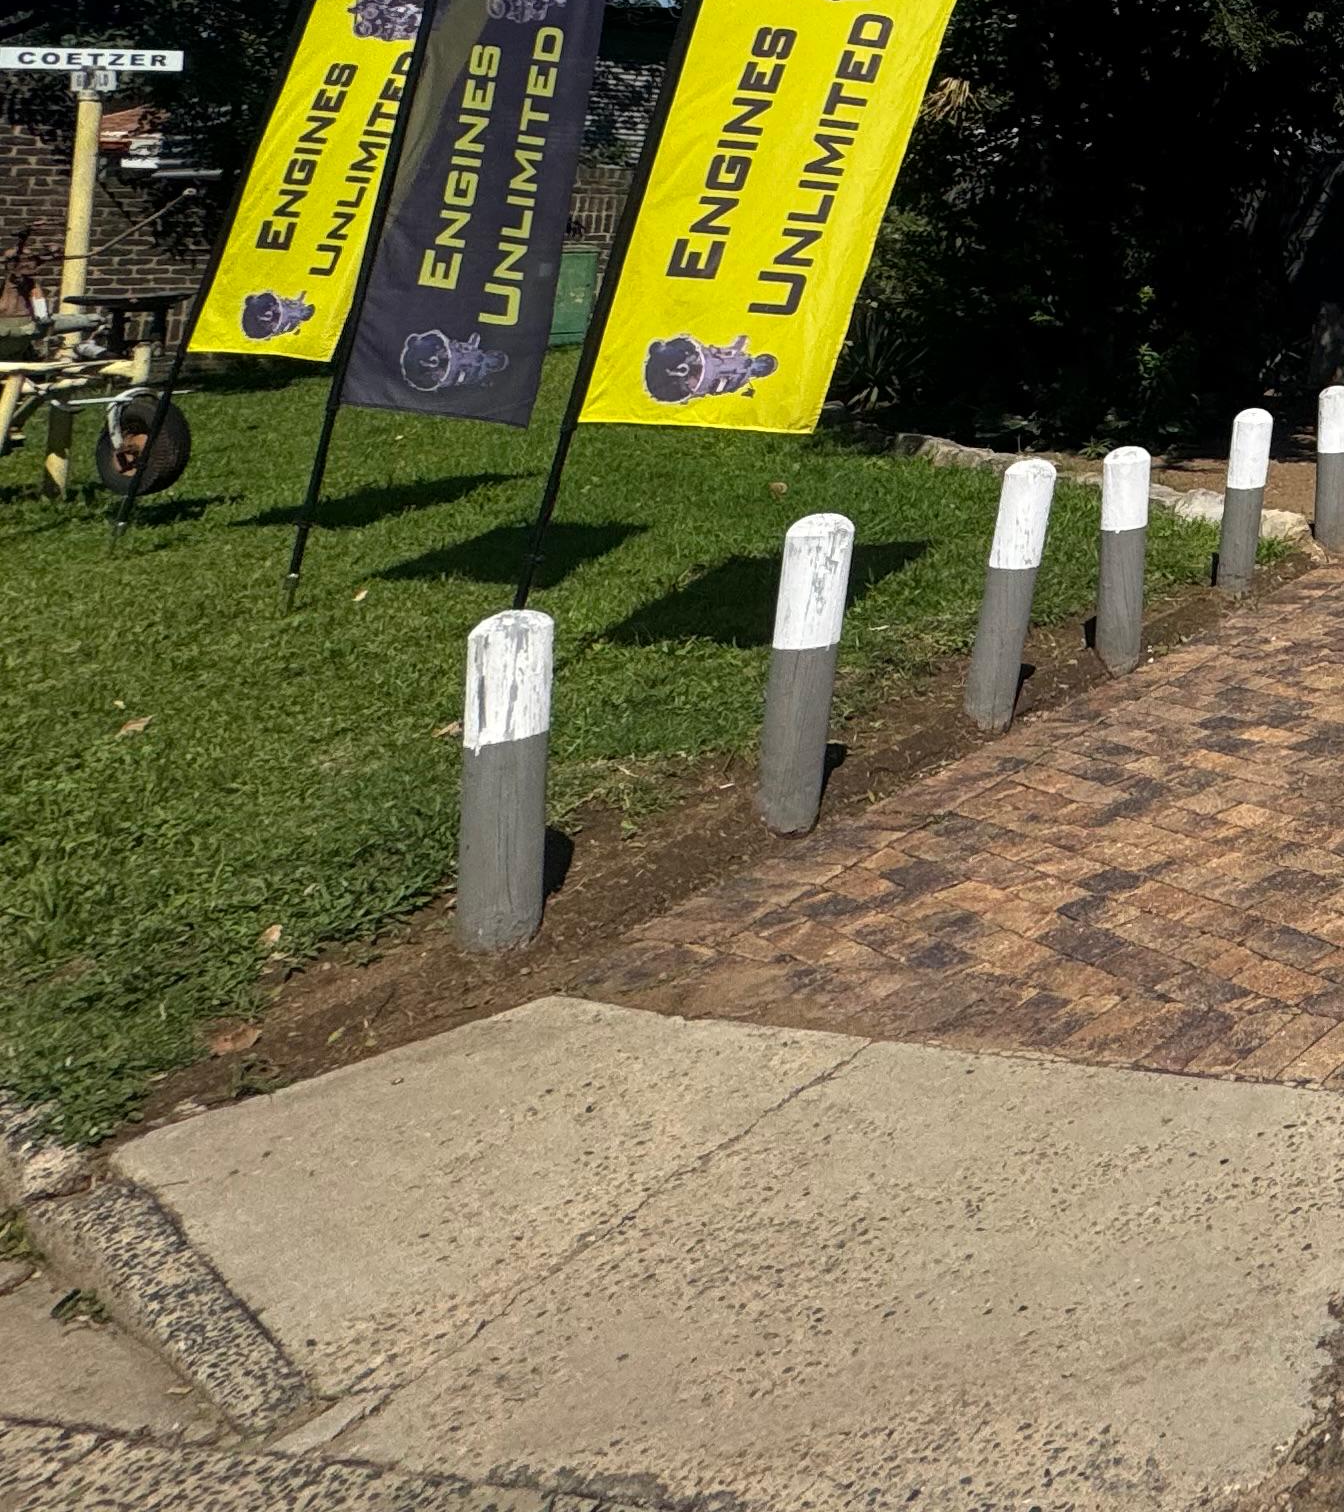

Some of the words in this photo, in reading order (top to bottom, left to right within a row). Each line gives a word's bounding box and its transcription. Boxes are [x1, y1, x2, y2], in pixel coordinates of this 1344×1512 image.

[17, 51, 167, 67] COETZER
[255, 62, 359, 252] ENGINES
[417, 44, 502, 290] ENGINES
[478, 26, 565, 326] UNLIMITED
[666, 26, 798, 280] ENGINES
[748, 13, 895, 316] UNLIMITED
